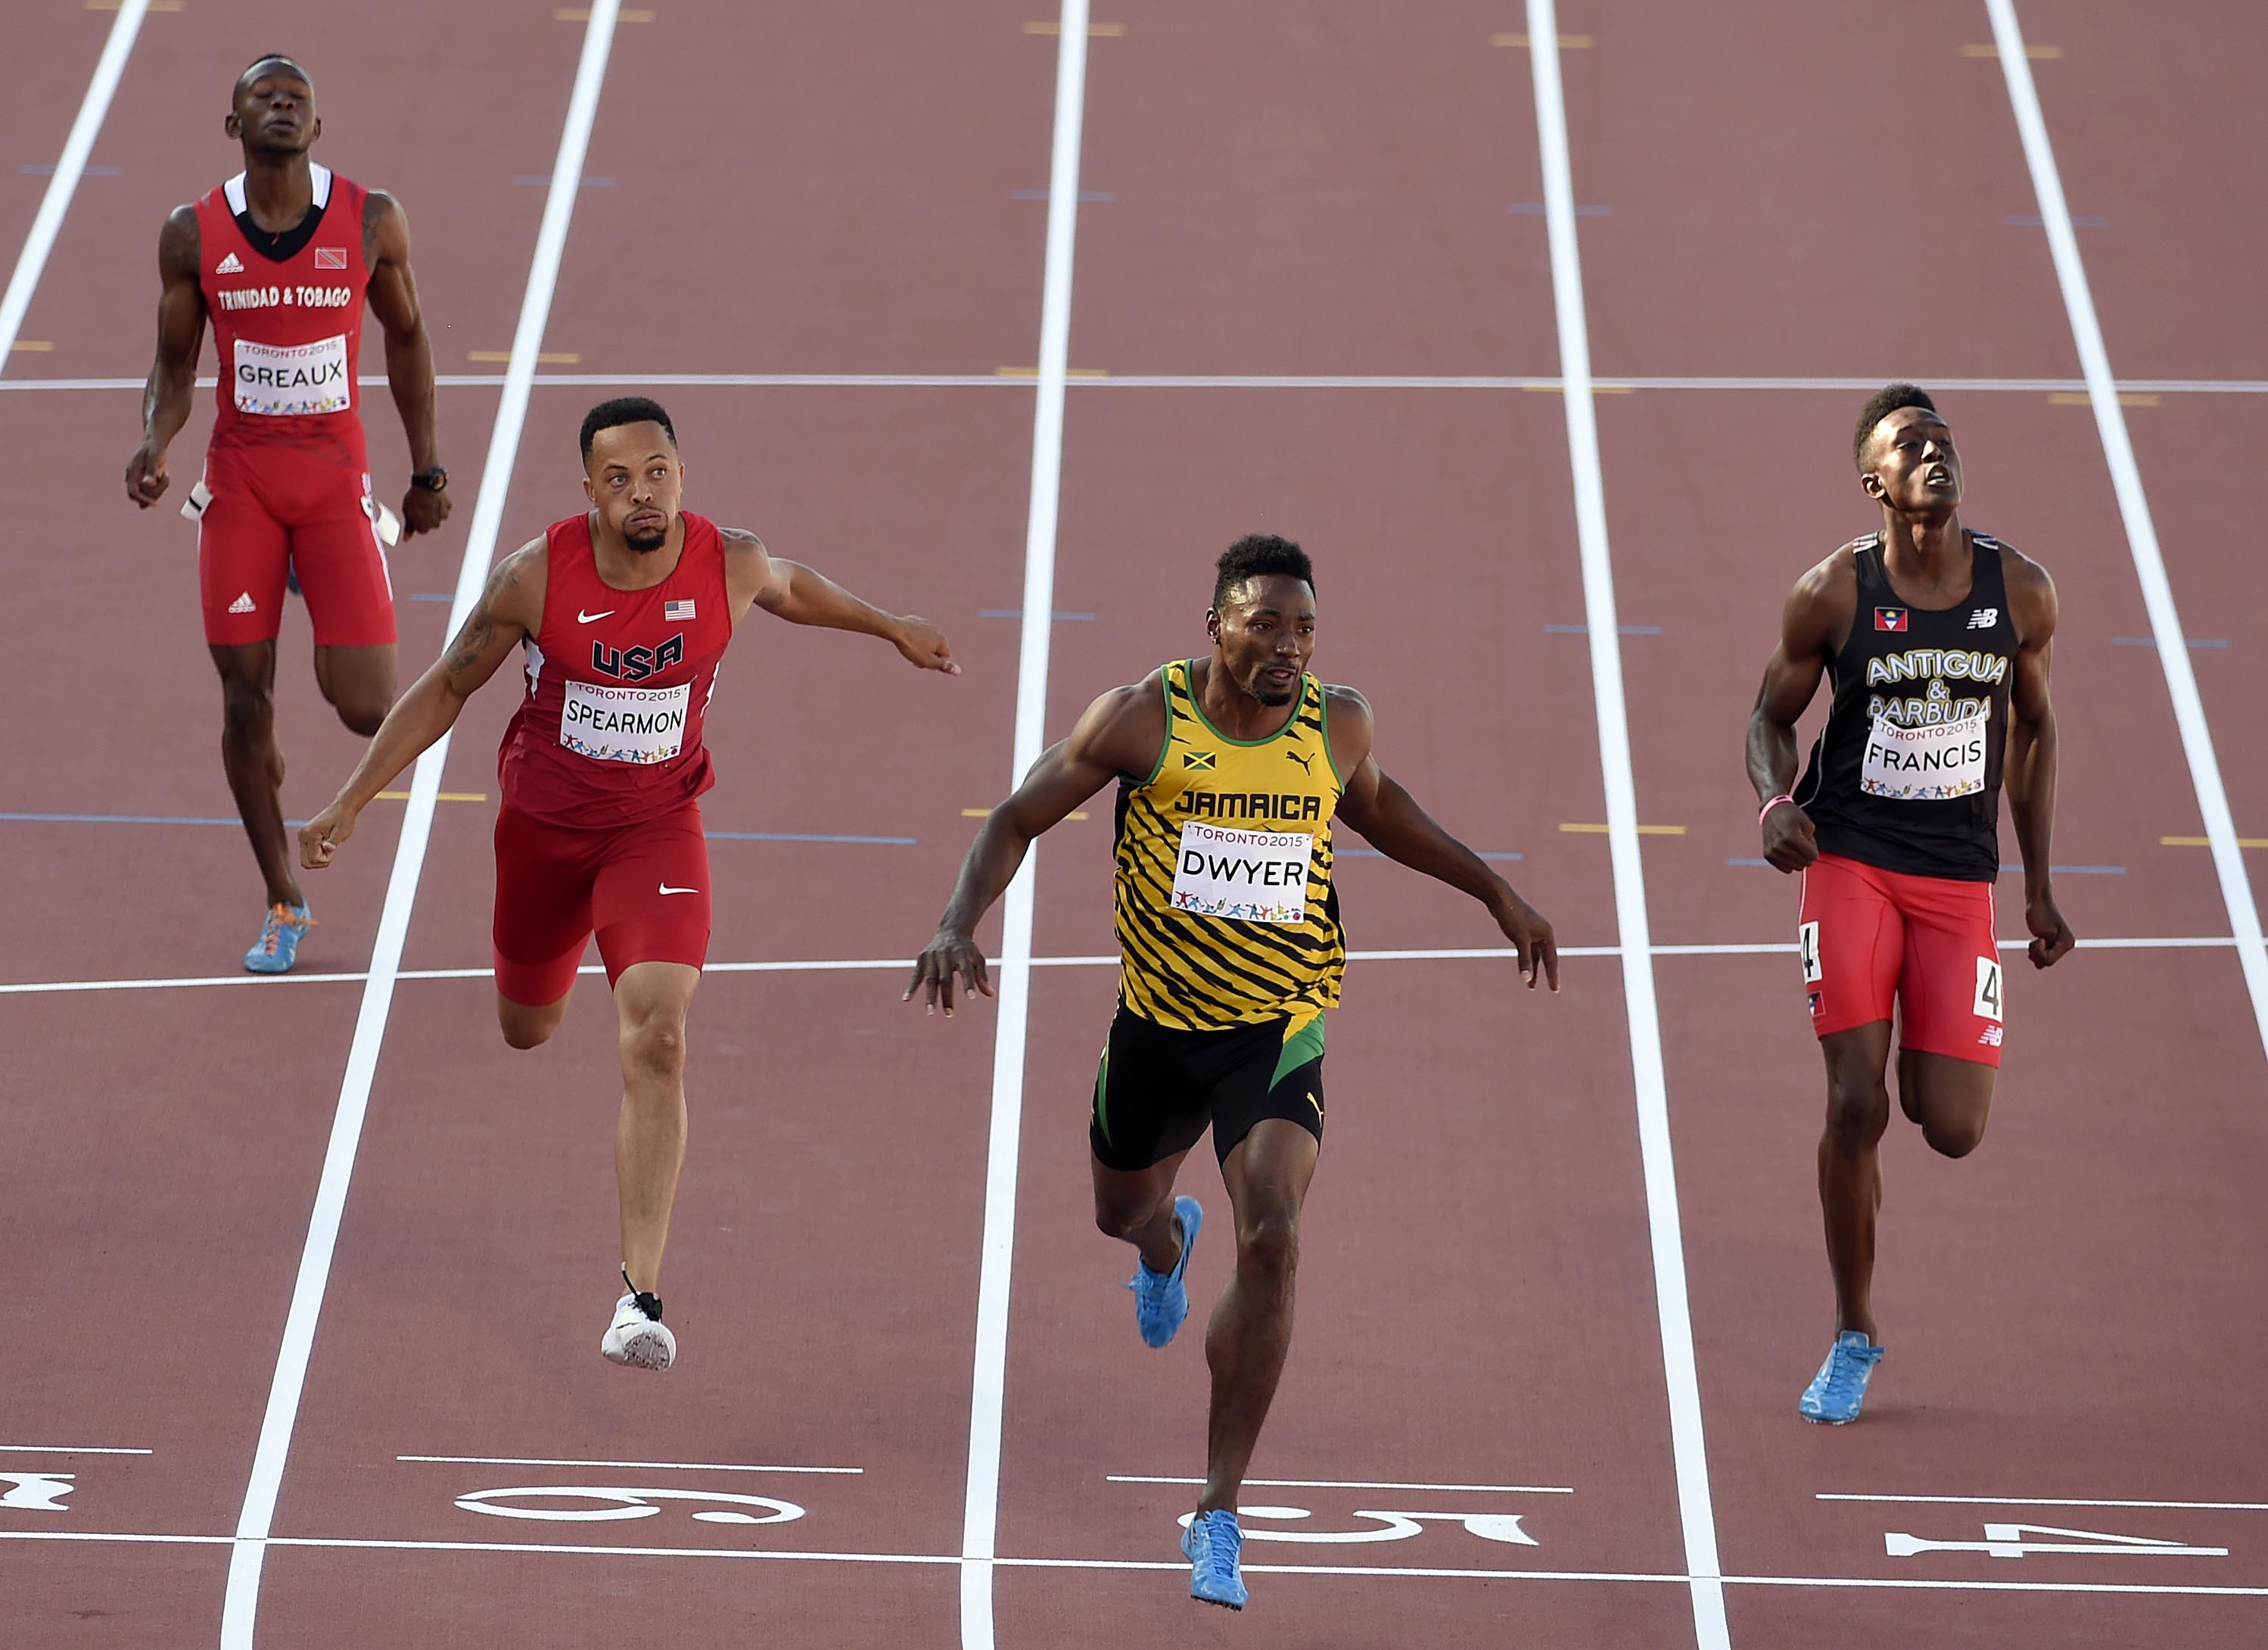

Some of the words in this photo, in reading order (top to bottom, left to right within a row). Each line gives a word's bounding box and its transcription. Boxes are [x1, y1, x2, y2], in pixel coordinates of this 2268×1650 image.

[217, 286, 280, 310] TRINIDAD
[283, 287, 294, 305] &
[296, 285, 351, 308] TOBAGO
[238, 360, 343, 388] GREAUX
[592, 631, 684, 682] USA
[1866, 649, 2008, 686] ANTIGUA
[1926, 680, 1950, 701] &
[566, 699, 683, 734] SPEARMON
[1866, 693, 1992, 726] BARBUDA
[1868, 739, 1981, 772] FRANCIS
[1174, 791, 1321, 821] JAMAICA
[1182, 849, 1304, 886] DWYER
[1803, 927, 1814, 978] 4
[1982, 965, 1999, 1016] 4
[453, 1486, 807, 1524] 6
[1176, 1505, 1541, 1546] 5
[1884, 1523, 2229, 1558] 4
